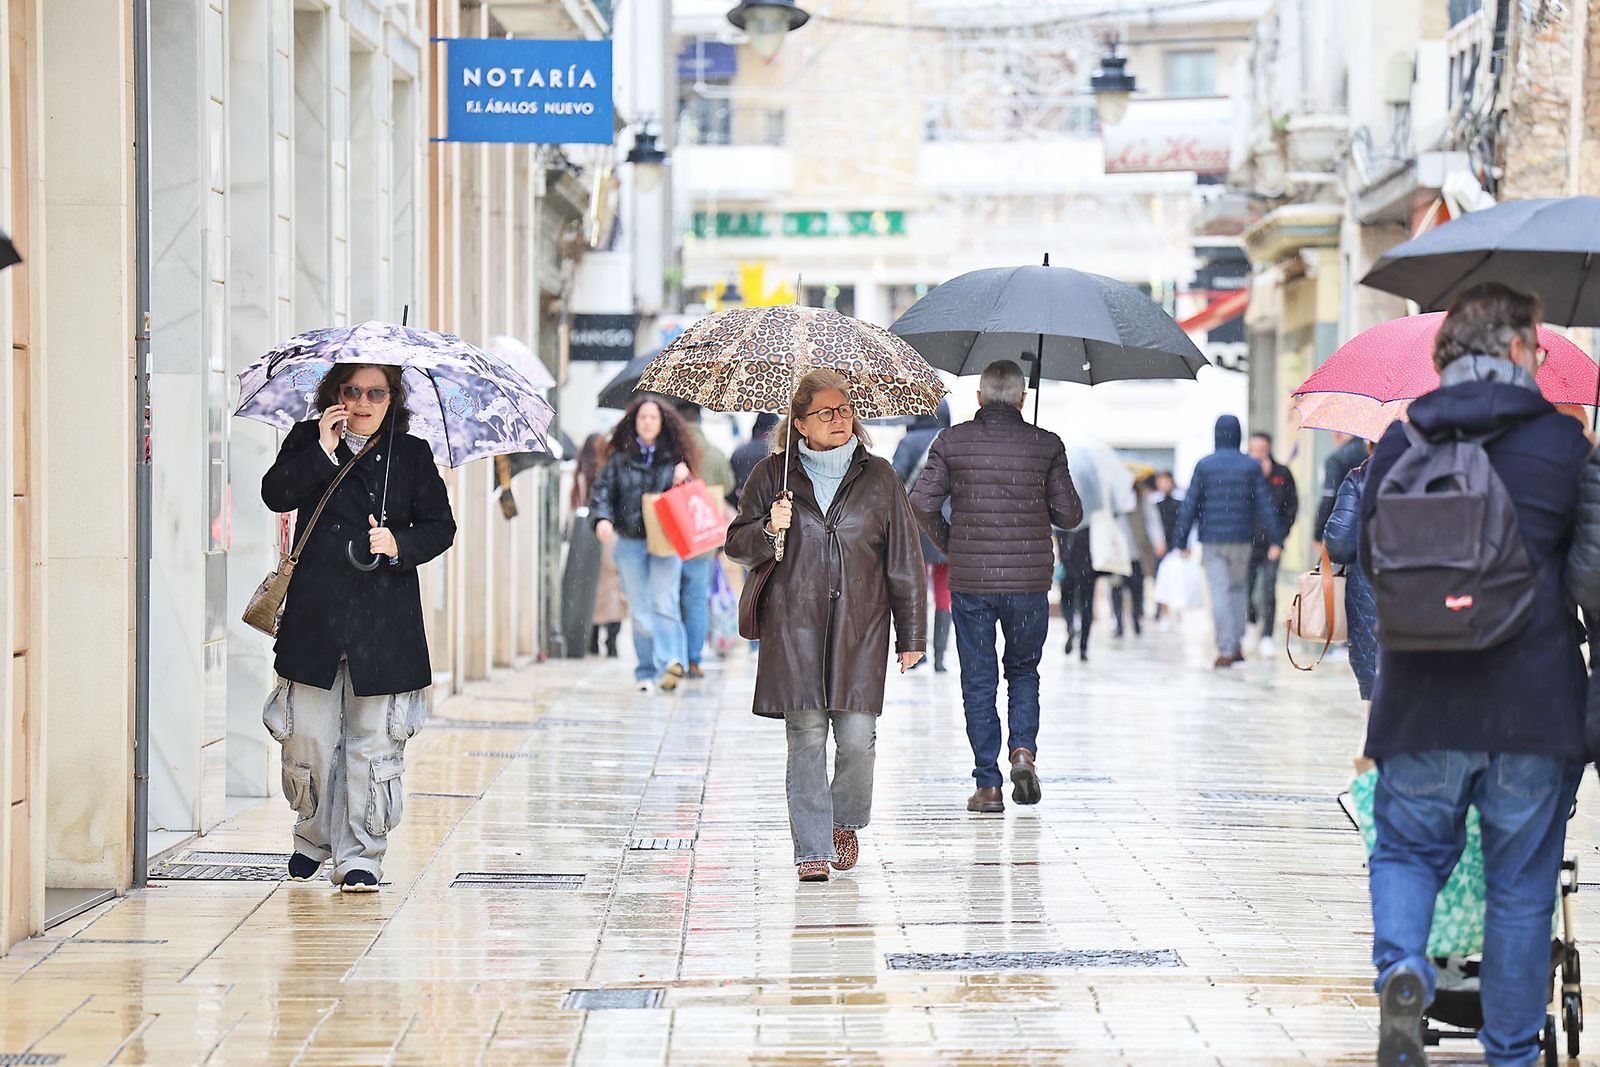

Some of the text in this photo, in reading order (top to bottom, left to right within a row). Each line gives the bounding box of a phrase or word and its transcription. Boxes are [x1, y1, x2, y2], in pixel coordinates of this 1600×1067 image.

[463, 63, 597, 89] NOTARÍA
[485, 97, 538, 114] ÁBALOS
[544, 101, 595, 115] NUEVO
